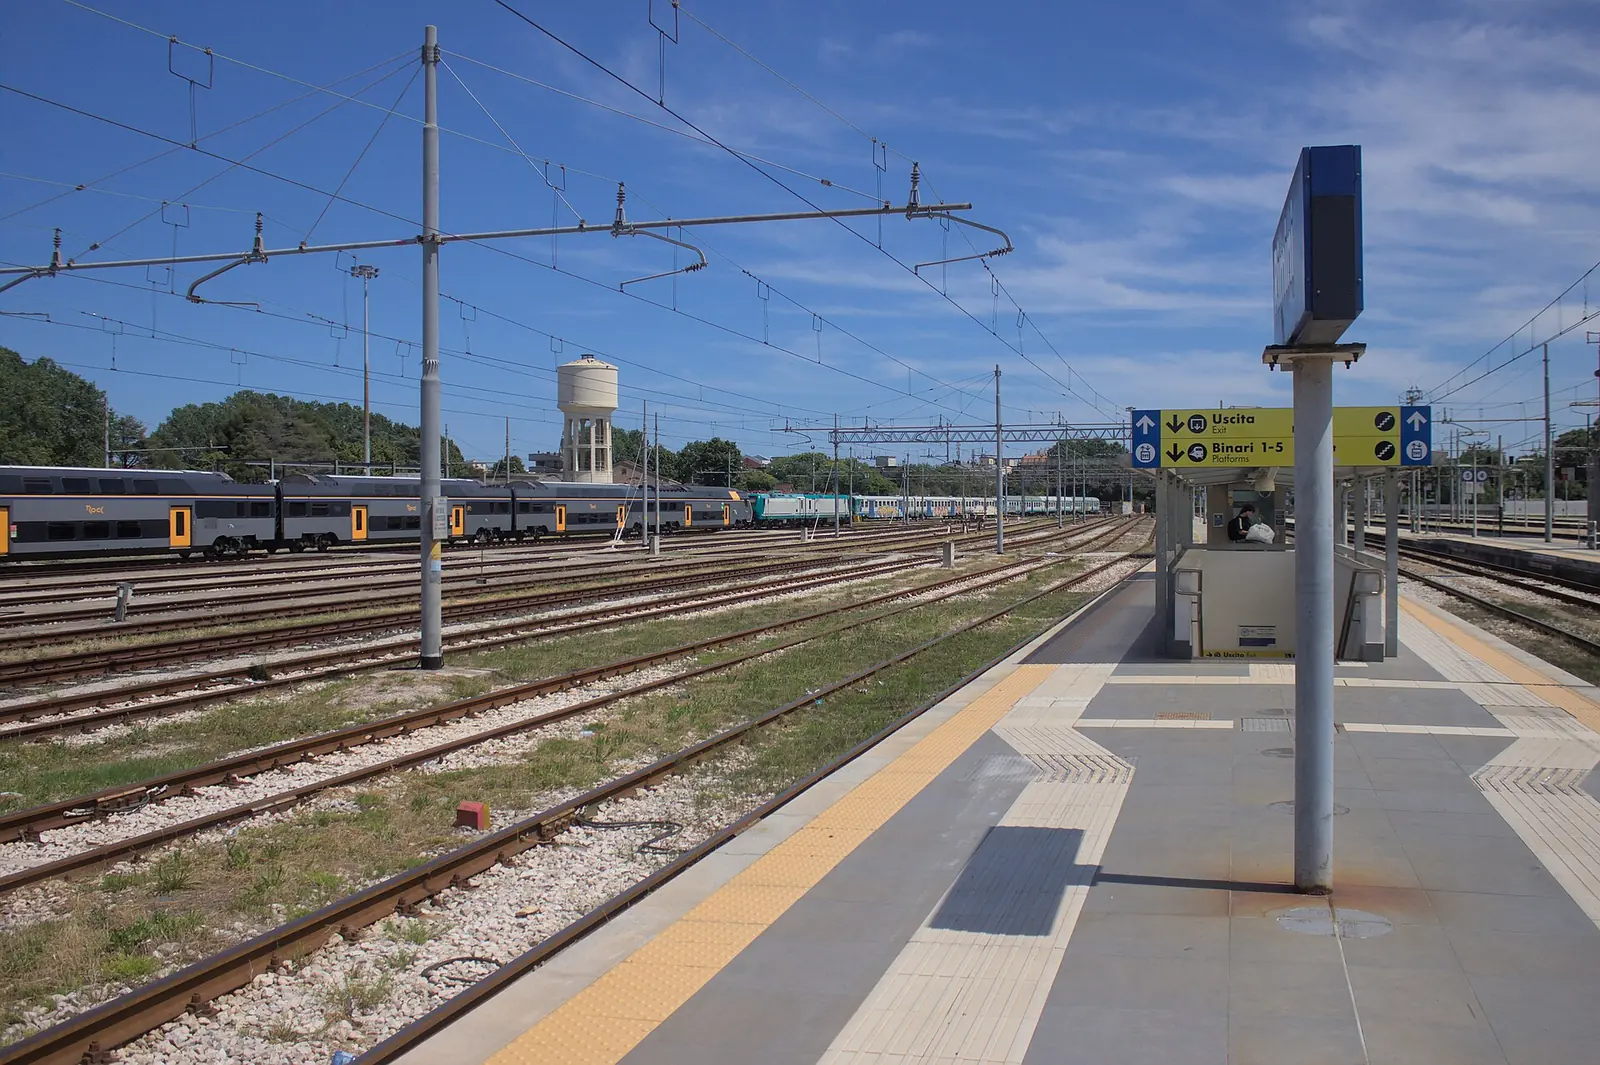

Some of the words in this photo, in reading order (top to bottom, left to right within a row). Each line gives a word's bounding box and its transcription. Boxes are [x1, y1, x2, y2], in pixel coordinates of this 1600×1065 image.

[1212, 413, 1255, 424] Uscita
[1212, 425, 1227, 434] Exit
[1212, 442, 1254, 453] Binari
[1261, 441, 1284, 453] 1-5
[1212, 454, 1250, 463] Platforms
